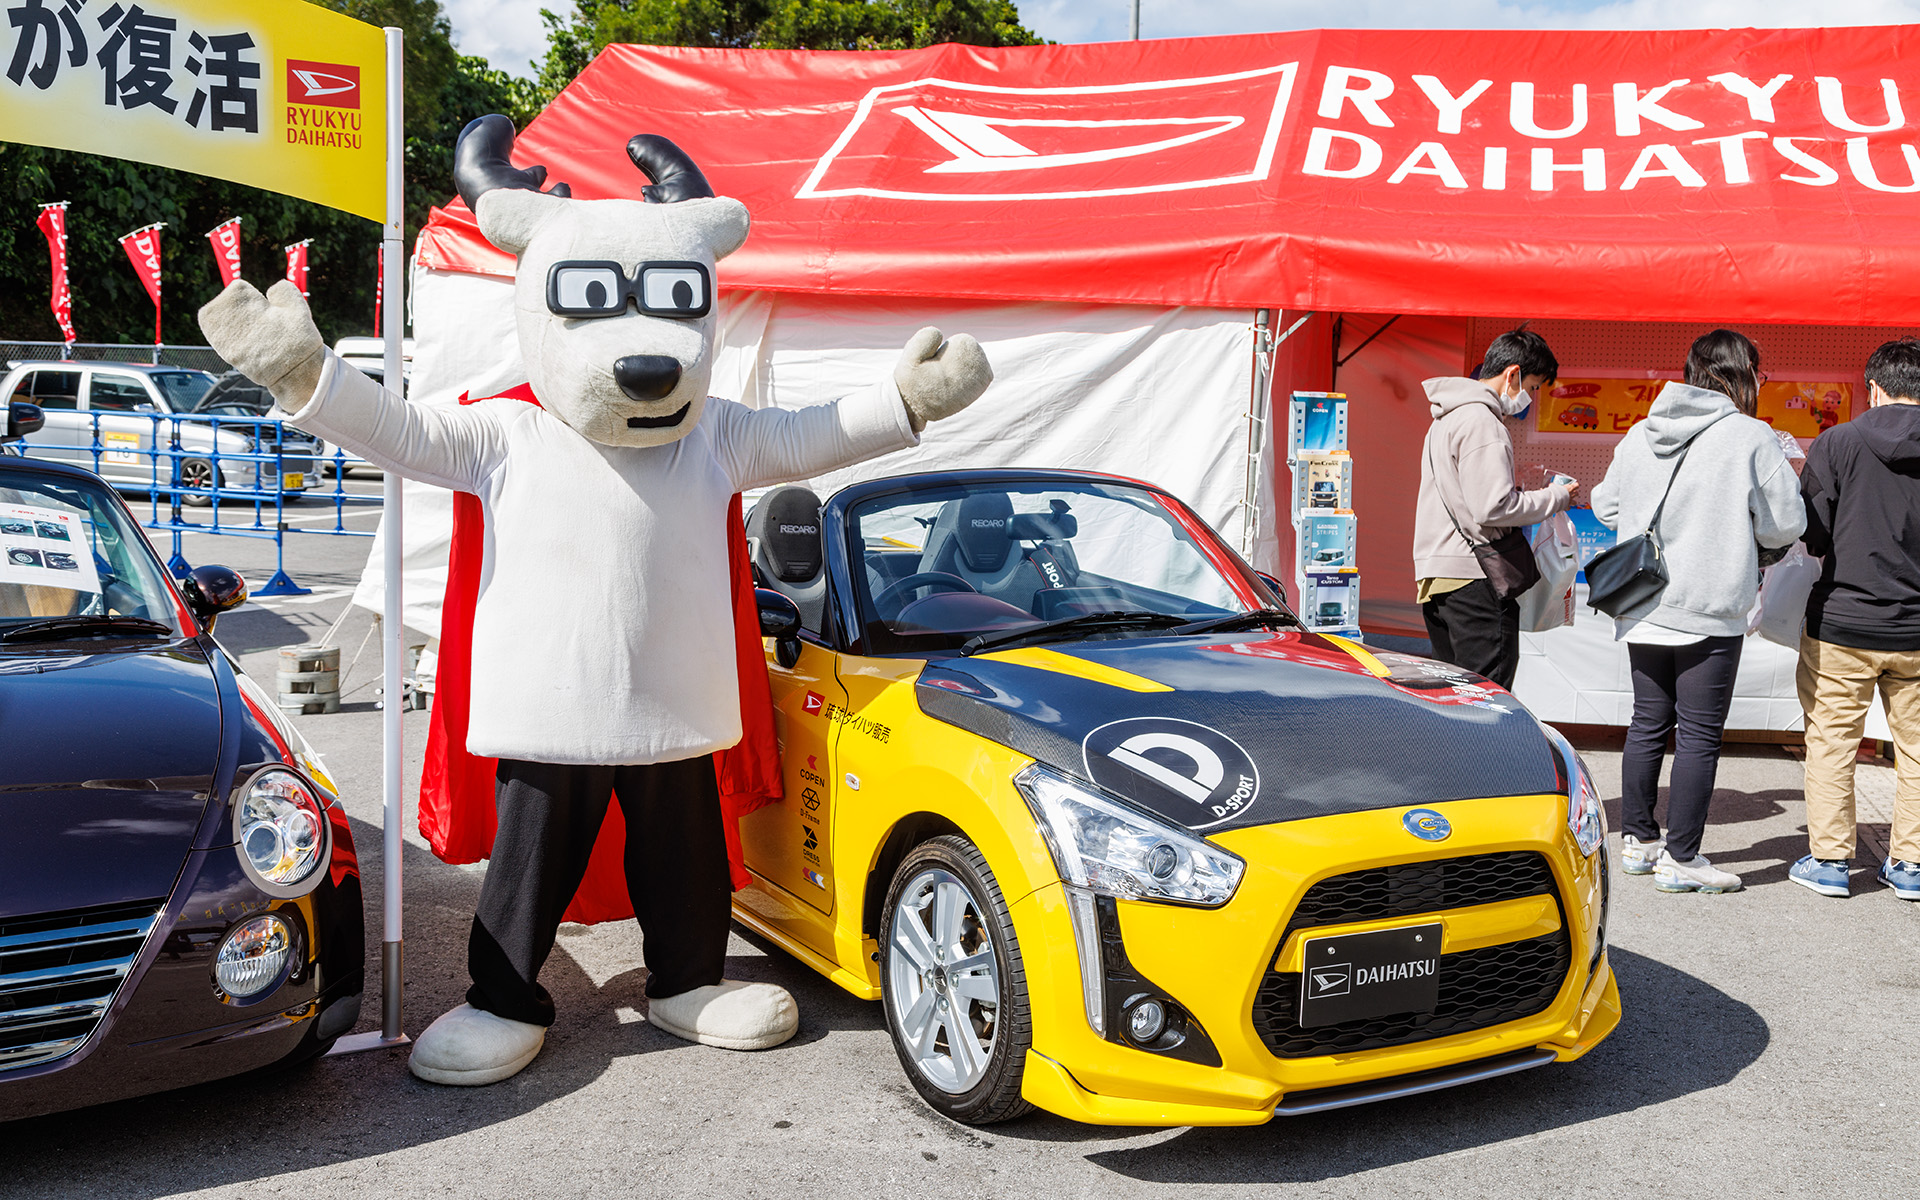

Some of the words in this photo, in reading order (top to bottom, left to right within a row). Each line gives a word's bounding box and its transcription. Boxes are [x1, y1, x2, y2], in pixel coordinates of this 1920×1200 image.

[6, 0, 262, 134] が復活
[1317, 64, 1907, 140] RYUKYU
[286, 106, 363, 131] RYUKYU
[286, 127, 363, 151] DAIHATSU
[1301, 126, 1920, 195] DAIHATSU
[780, 524, 817, 535] RECARO
[971, 518, 1005, 528] RECARO
[824, 702, 892, 745] 琉球ダイハツ販売
[799, 768, 825, 788] COPEN
[1211, 774, 1254, 819] D-SPORT
[1356, 958, 1436, 986] DAIHATSU
